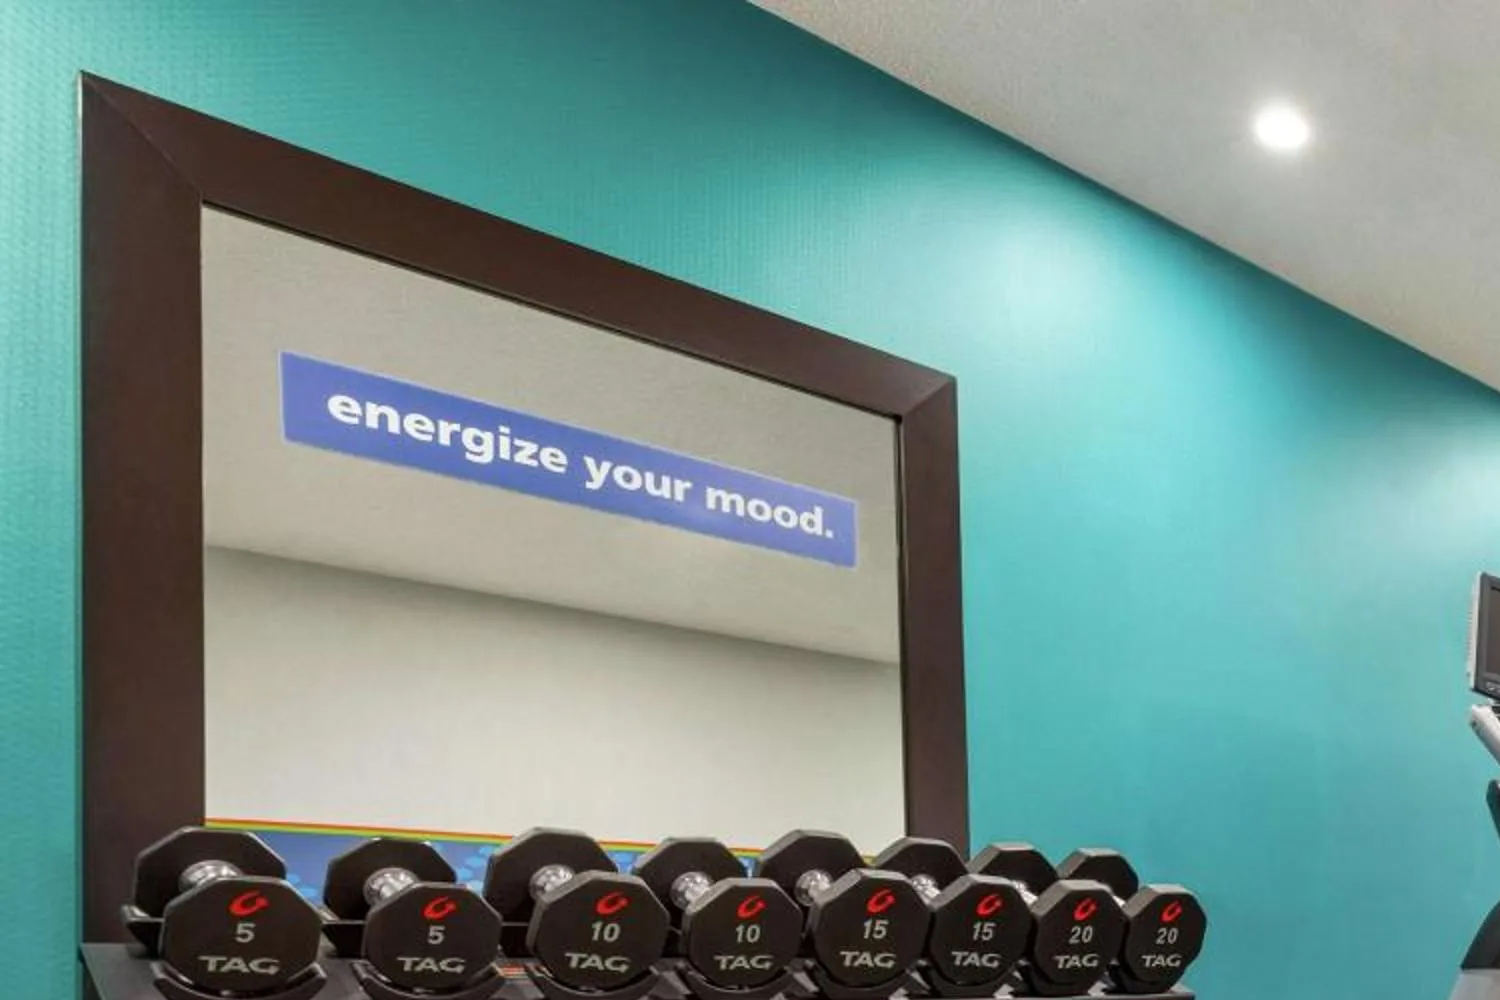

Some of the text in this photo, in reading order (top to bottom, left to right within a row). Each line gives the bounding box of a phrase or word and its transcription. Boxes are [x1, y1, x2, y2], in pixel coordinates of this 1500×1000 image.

[326, 392, 835, 540] energize your mood.
[235, 922, 256, 944] 5
[427, 925, 446, 945] 5
[591, 920, 621, 943] 10
[735, 924, 761, 944] 10
[863, 918, 889, 940] 15
[972, 921, 997, 942] 15
[1068, 924, 1094, 945] 20
[1155, 927, 1179, 945] 20
[198, 955, 280, 976] TAG
[396, 956, 466, 974] TAG
[564, 951, 629, 973] TAG
[713, 954, 773, 971] TAG
[839, 950, 896, 969] TAG
[951, 950, 1001, 969] TAG
[1053, 953, 1099, 969] TAG
[1141, 953, 1182, 968] TAG
